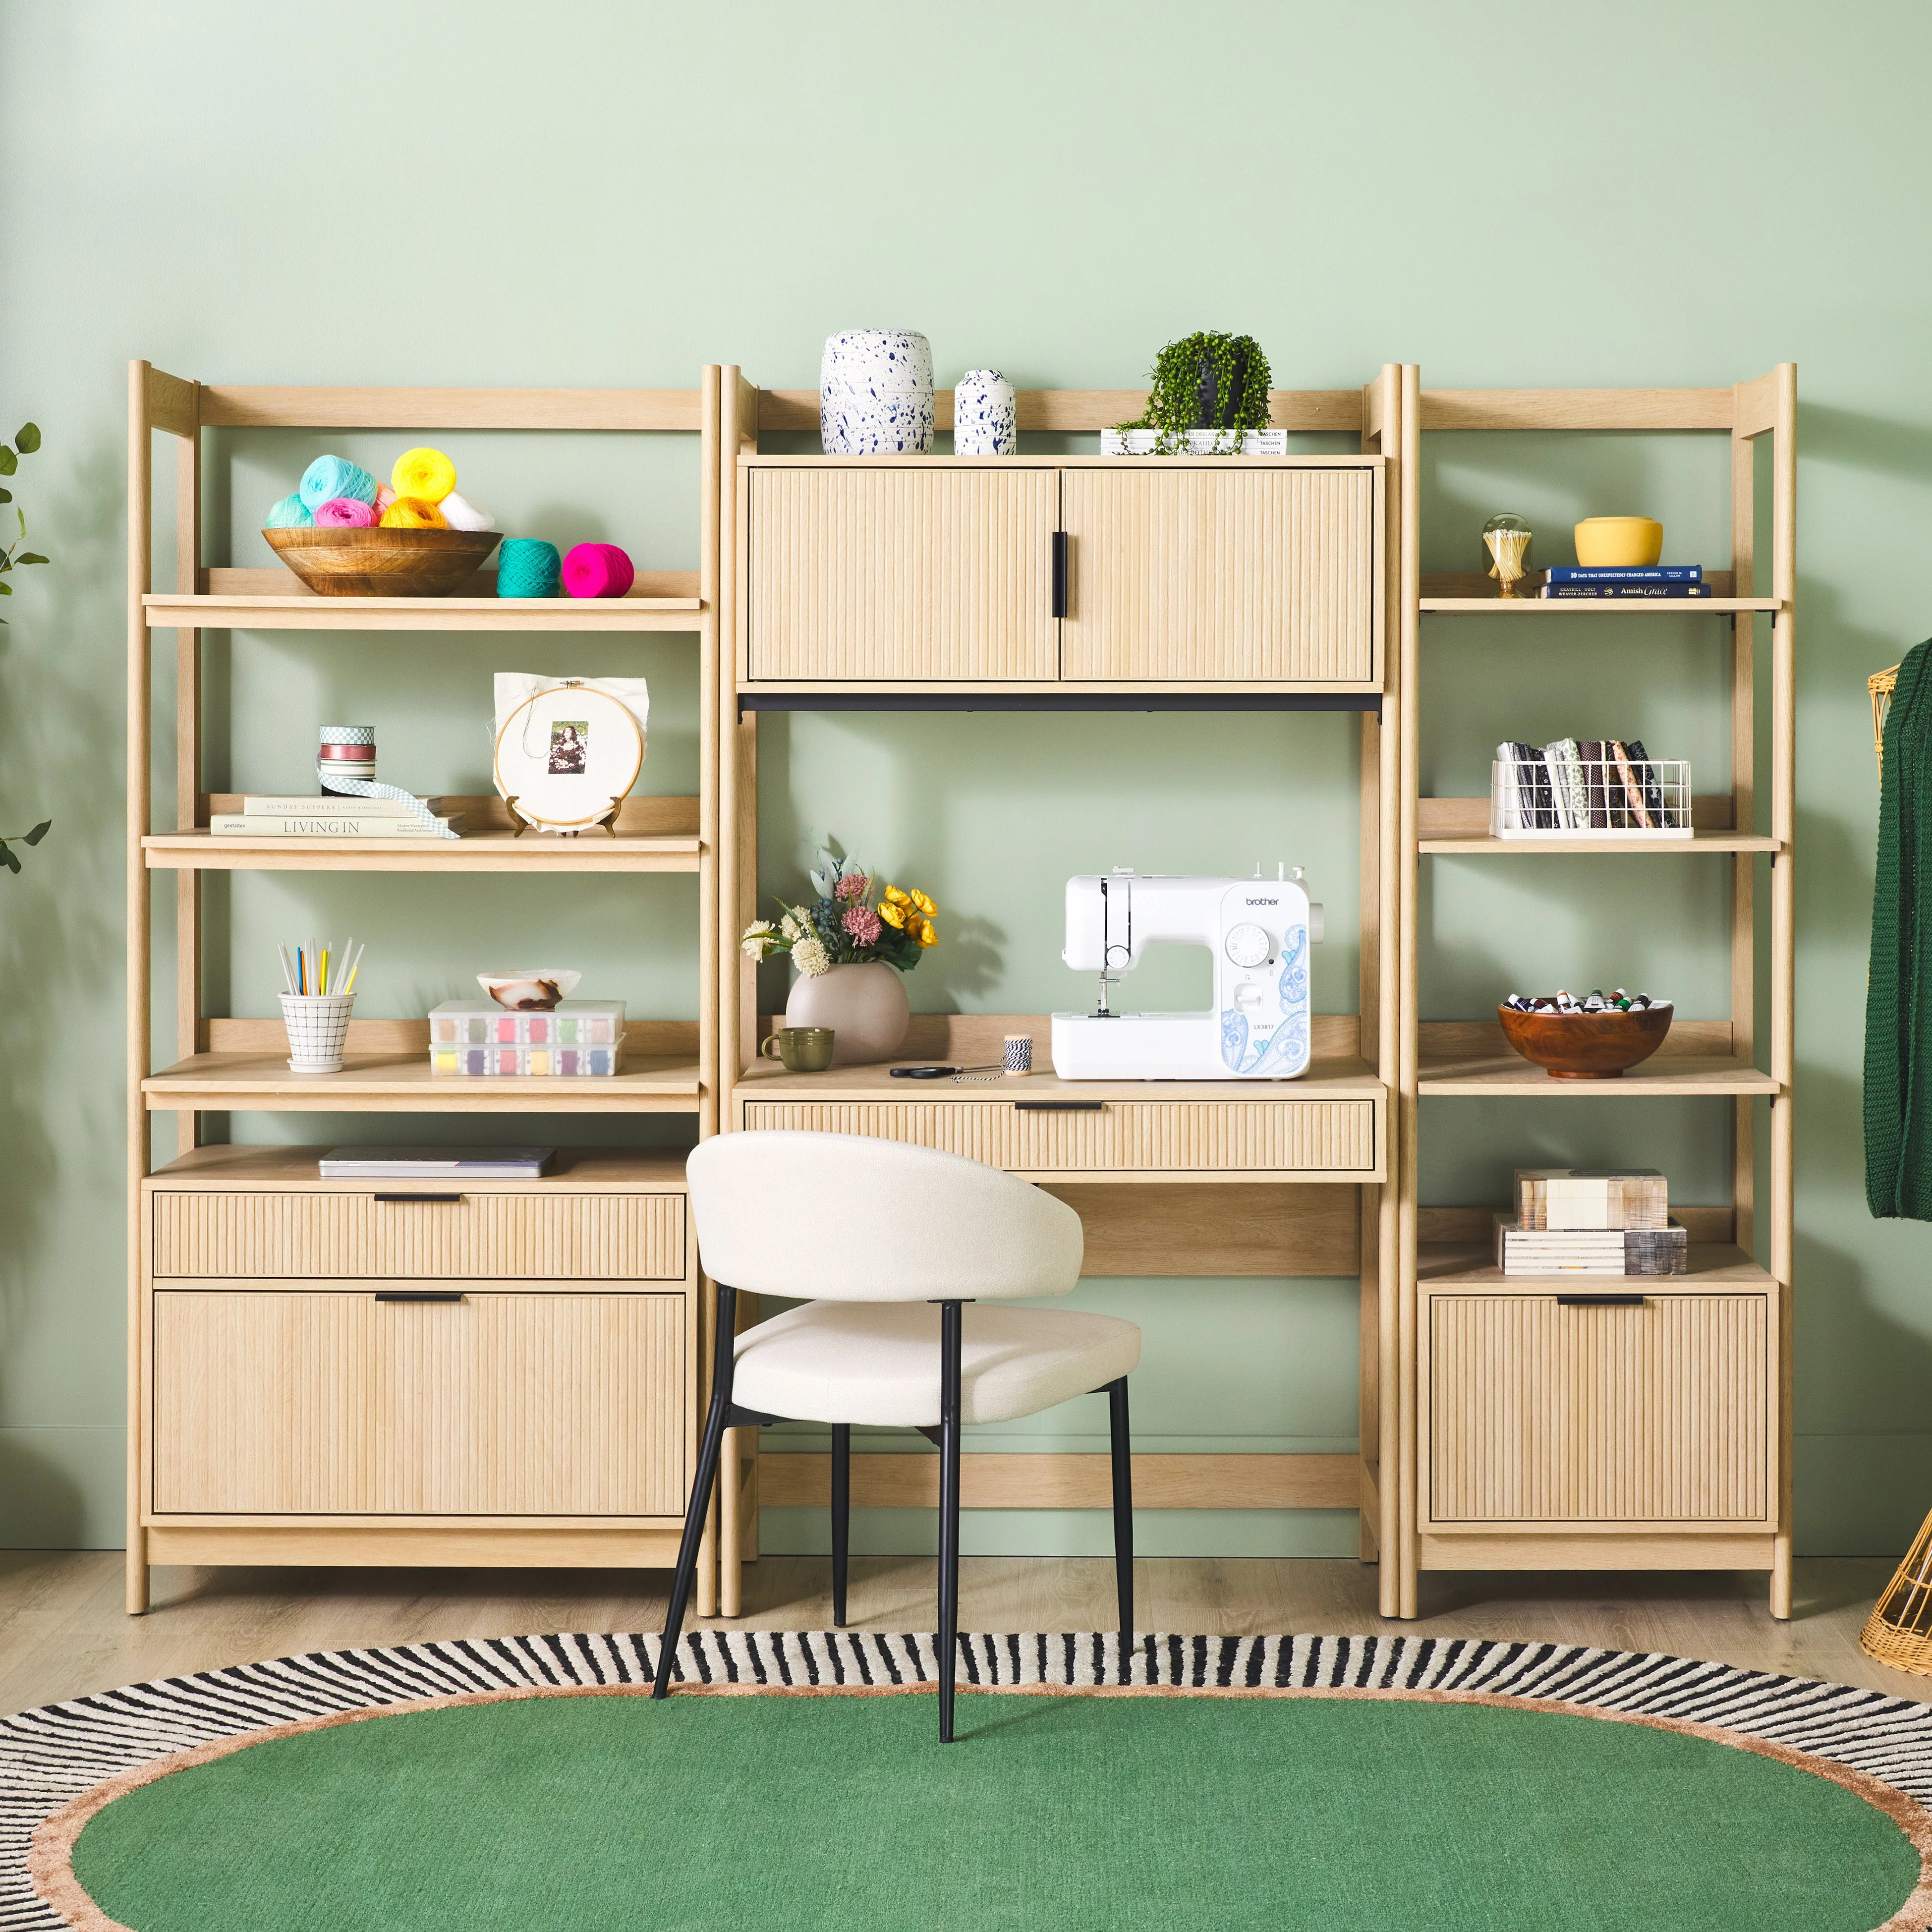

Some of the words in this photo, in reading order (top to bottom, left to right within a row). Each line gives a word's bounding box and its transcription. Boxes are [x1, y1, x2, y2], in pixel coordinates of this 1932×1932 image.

[1644, 586, 1668, 598] Grace
[284, 821, 339, 833] LIVING
[343, 822, 359, 833] IN
